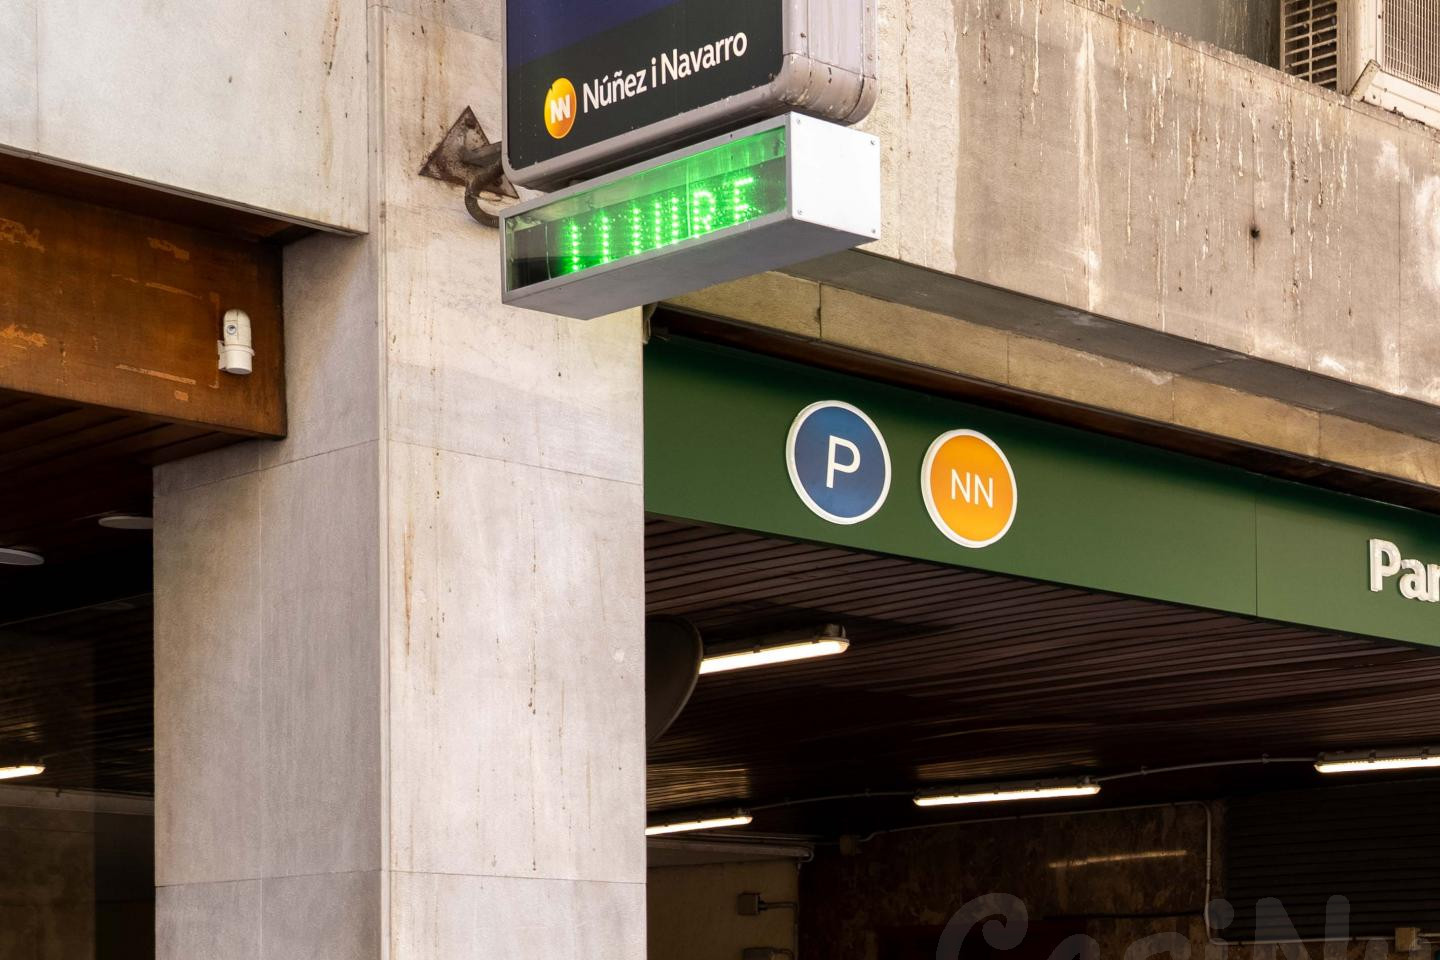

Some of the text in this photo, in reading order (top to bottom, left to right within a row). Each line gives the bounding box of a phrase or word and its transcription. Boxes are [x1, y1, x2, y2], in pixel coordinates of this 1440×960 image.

[582, 69, 648, 114] Núñez
[651, 57, 658, 90] i
[660, 32, 748, 85] Navarro
[826, 435, 861, 489] P
[950, 468, 994, 509] NN
